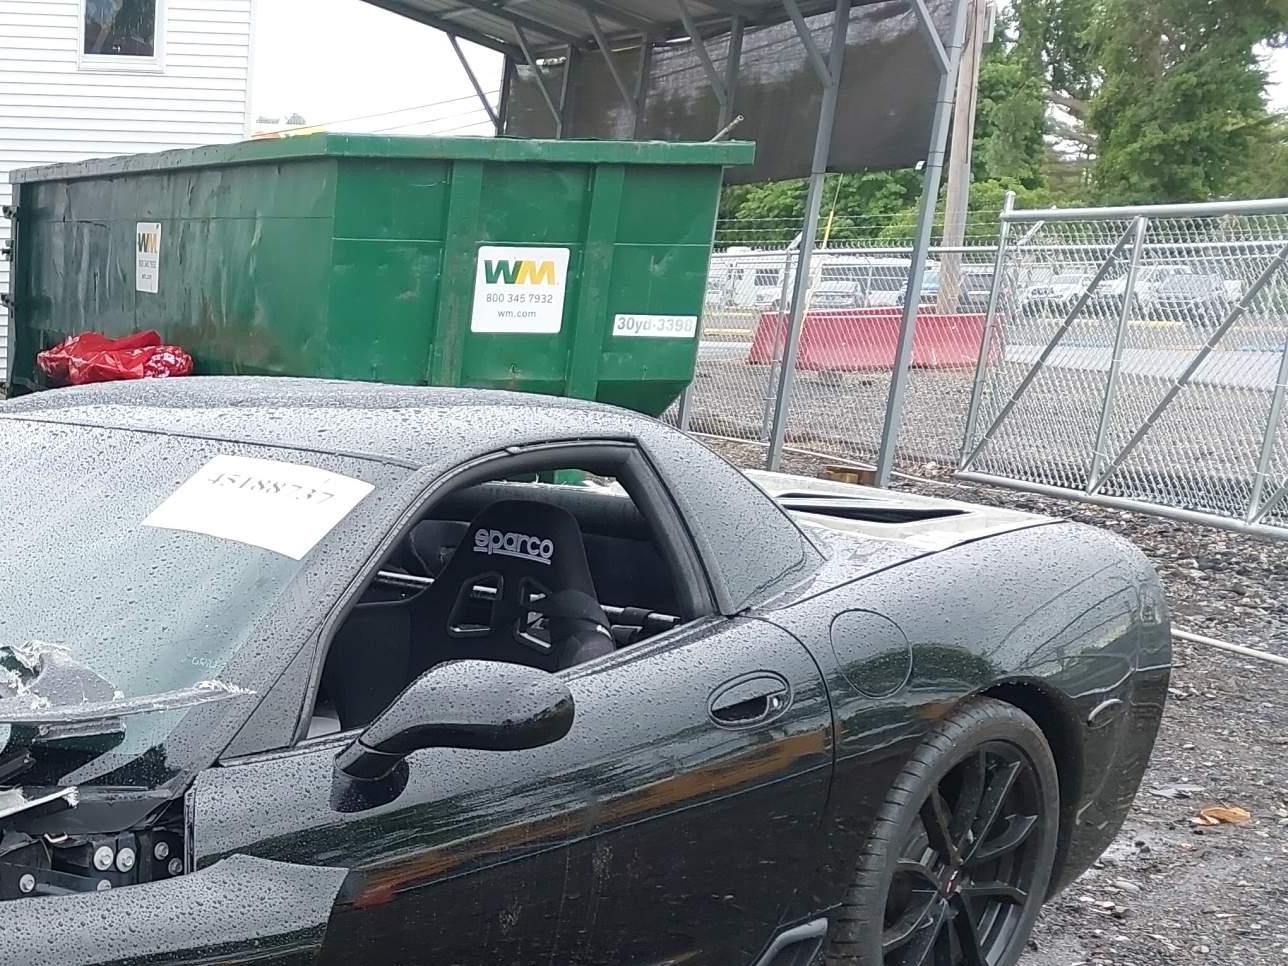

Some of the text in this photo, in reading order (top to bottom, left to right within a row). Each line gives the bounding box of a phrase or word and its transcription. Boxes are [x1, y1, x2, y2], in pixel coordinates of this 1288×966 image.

[484, 260, 556, 285] WM
[486, 293, 553, 304] 800 345 7932
[475, 528, 554, 559] sparco
